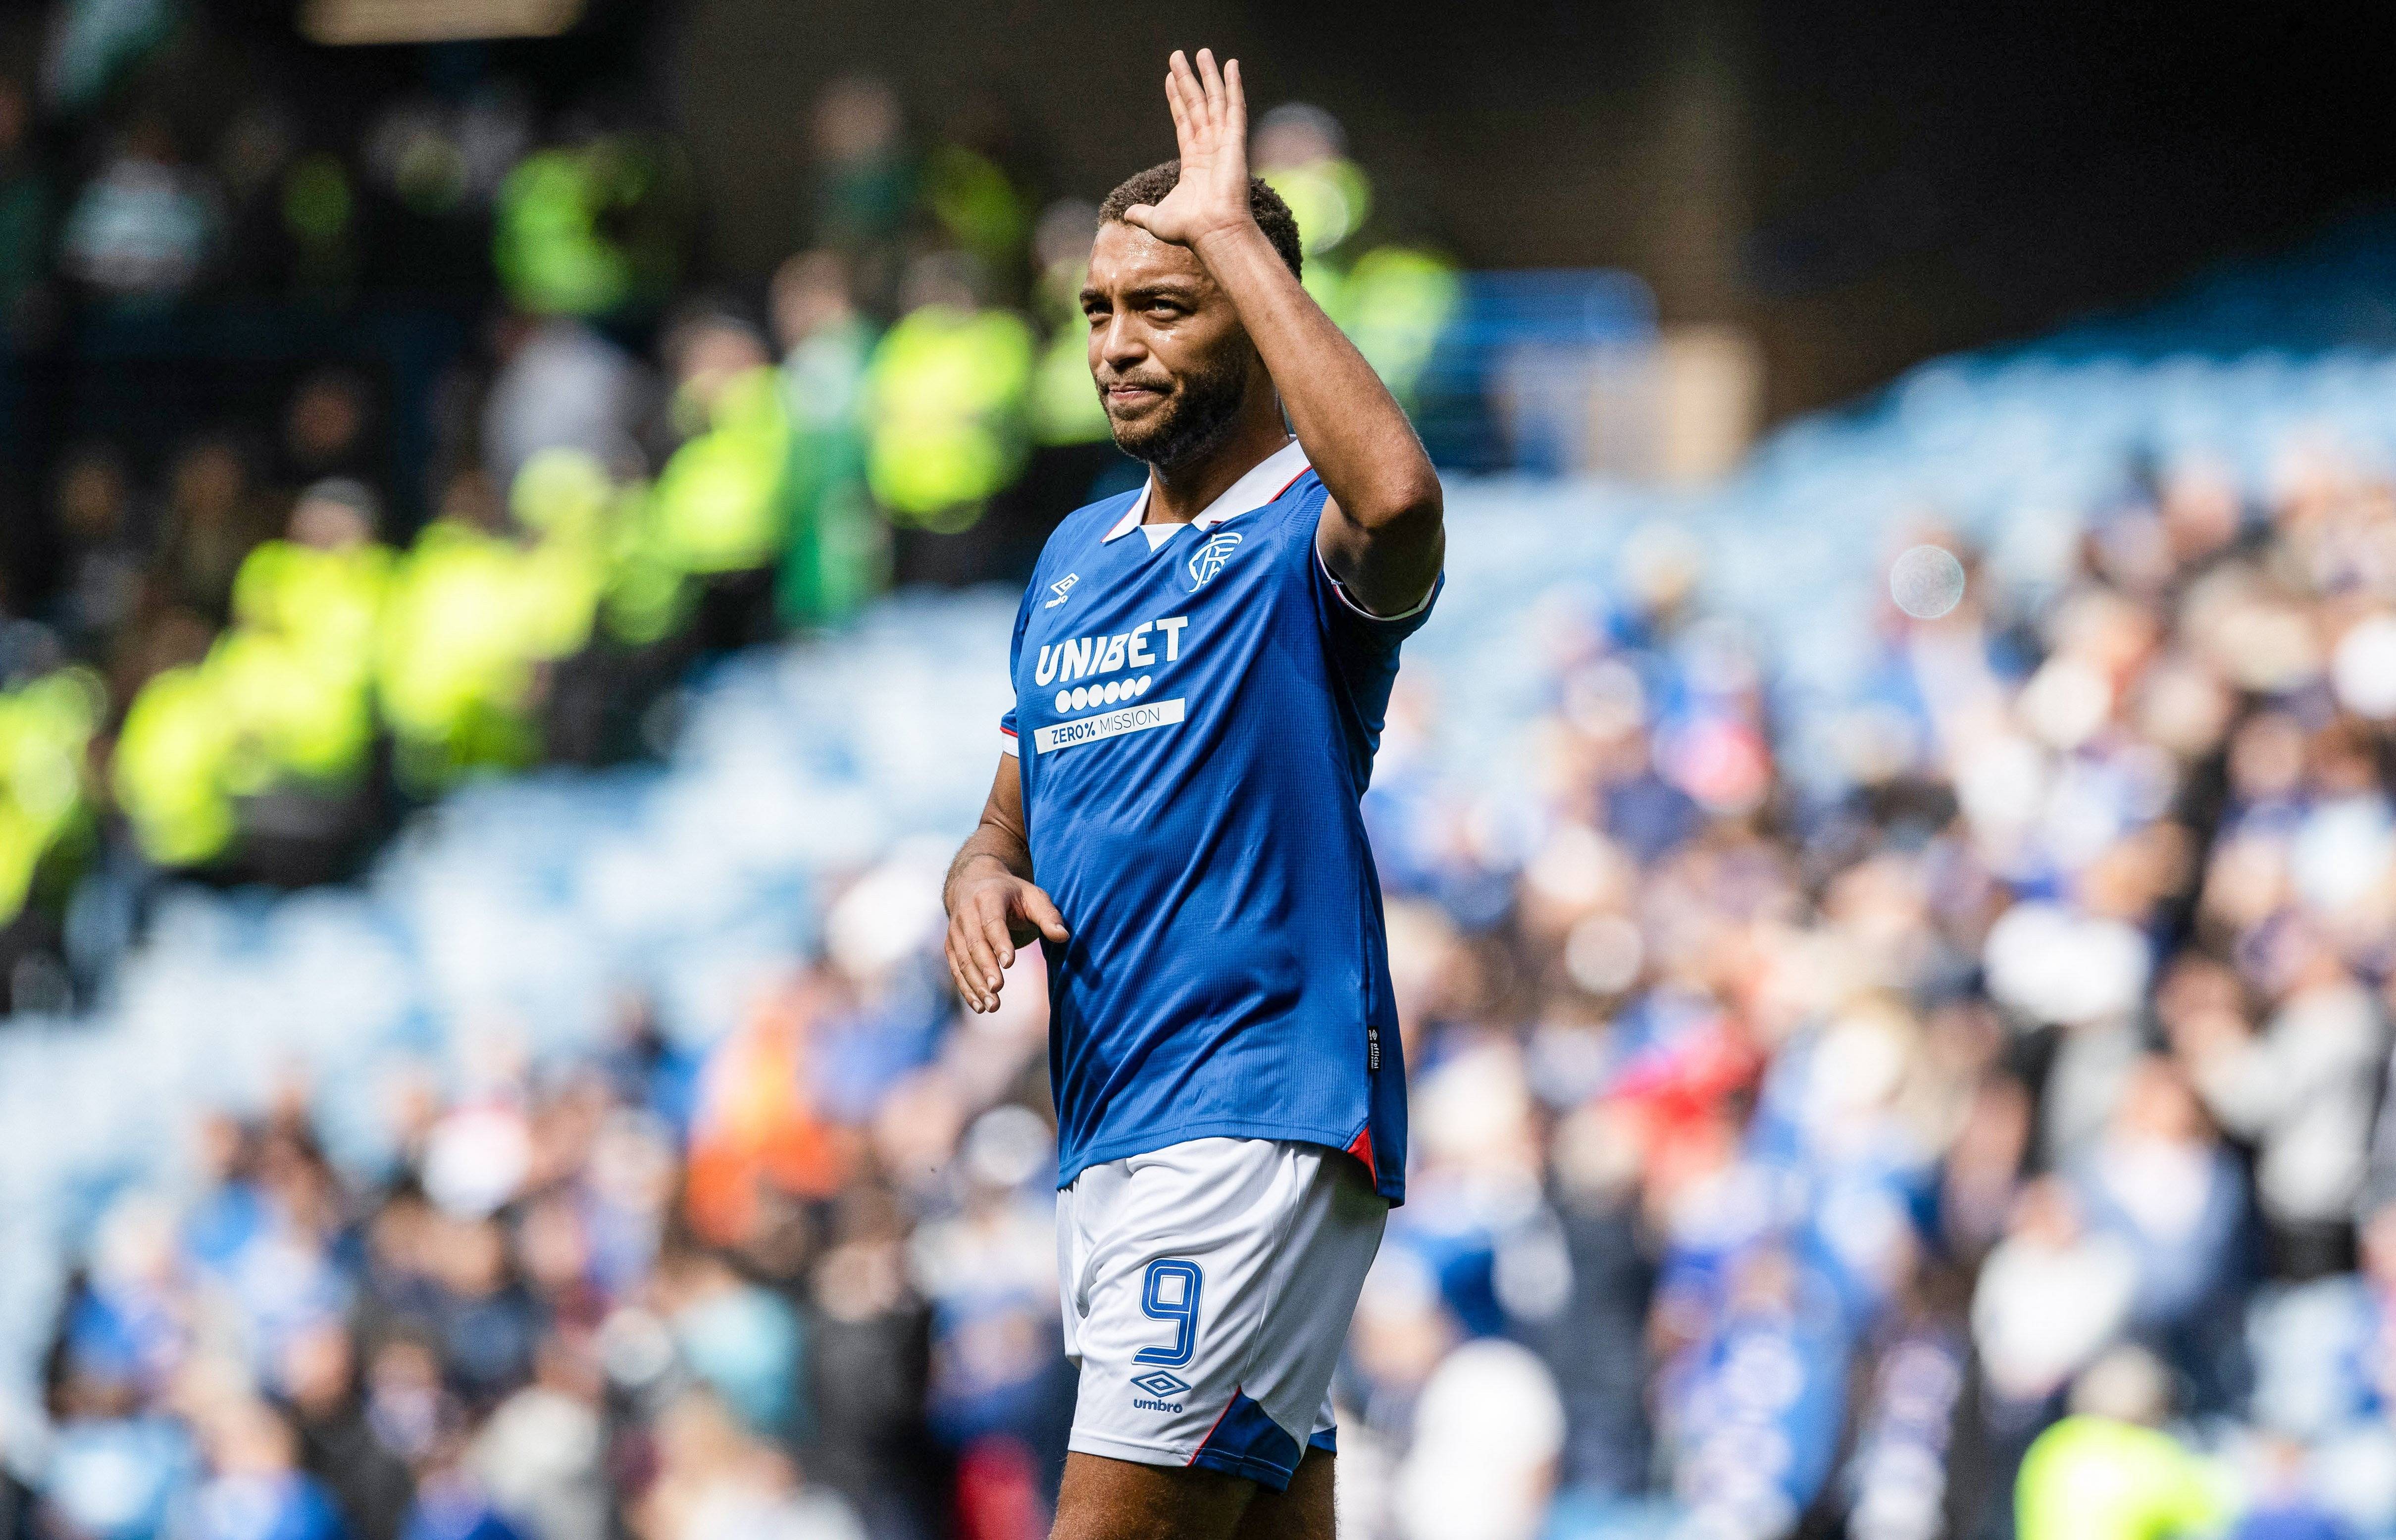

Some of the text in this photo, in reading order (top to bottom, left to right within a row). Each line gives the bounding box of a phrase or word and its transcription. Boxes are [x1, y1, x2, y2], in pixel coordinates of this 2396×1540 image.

[1045, 595, 1068, 609] umbo
[1035, 616, 1188, 686] UNIBET
[1051, 707, 1160, 745] ZERO% MISSION
[1131, 1257, 1205, 1369] 9
[1133, 1398, 1183, 1414] umbro
